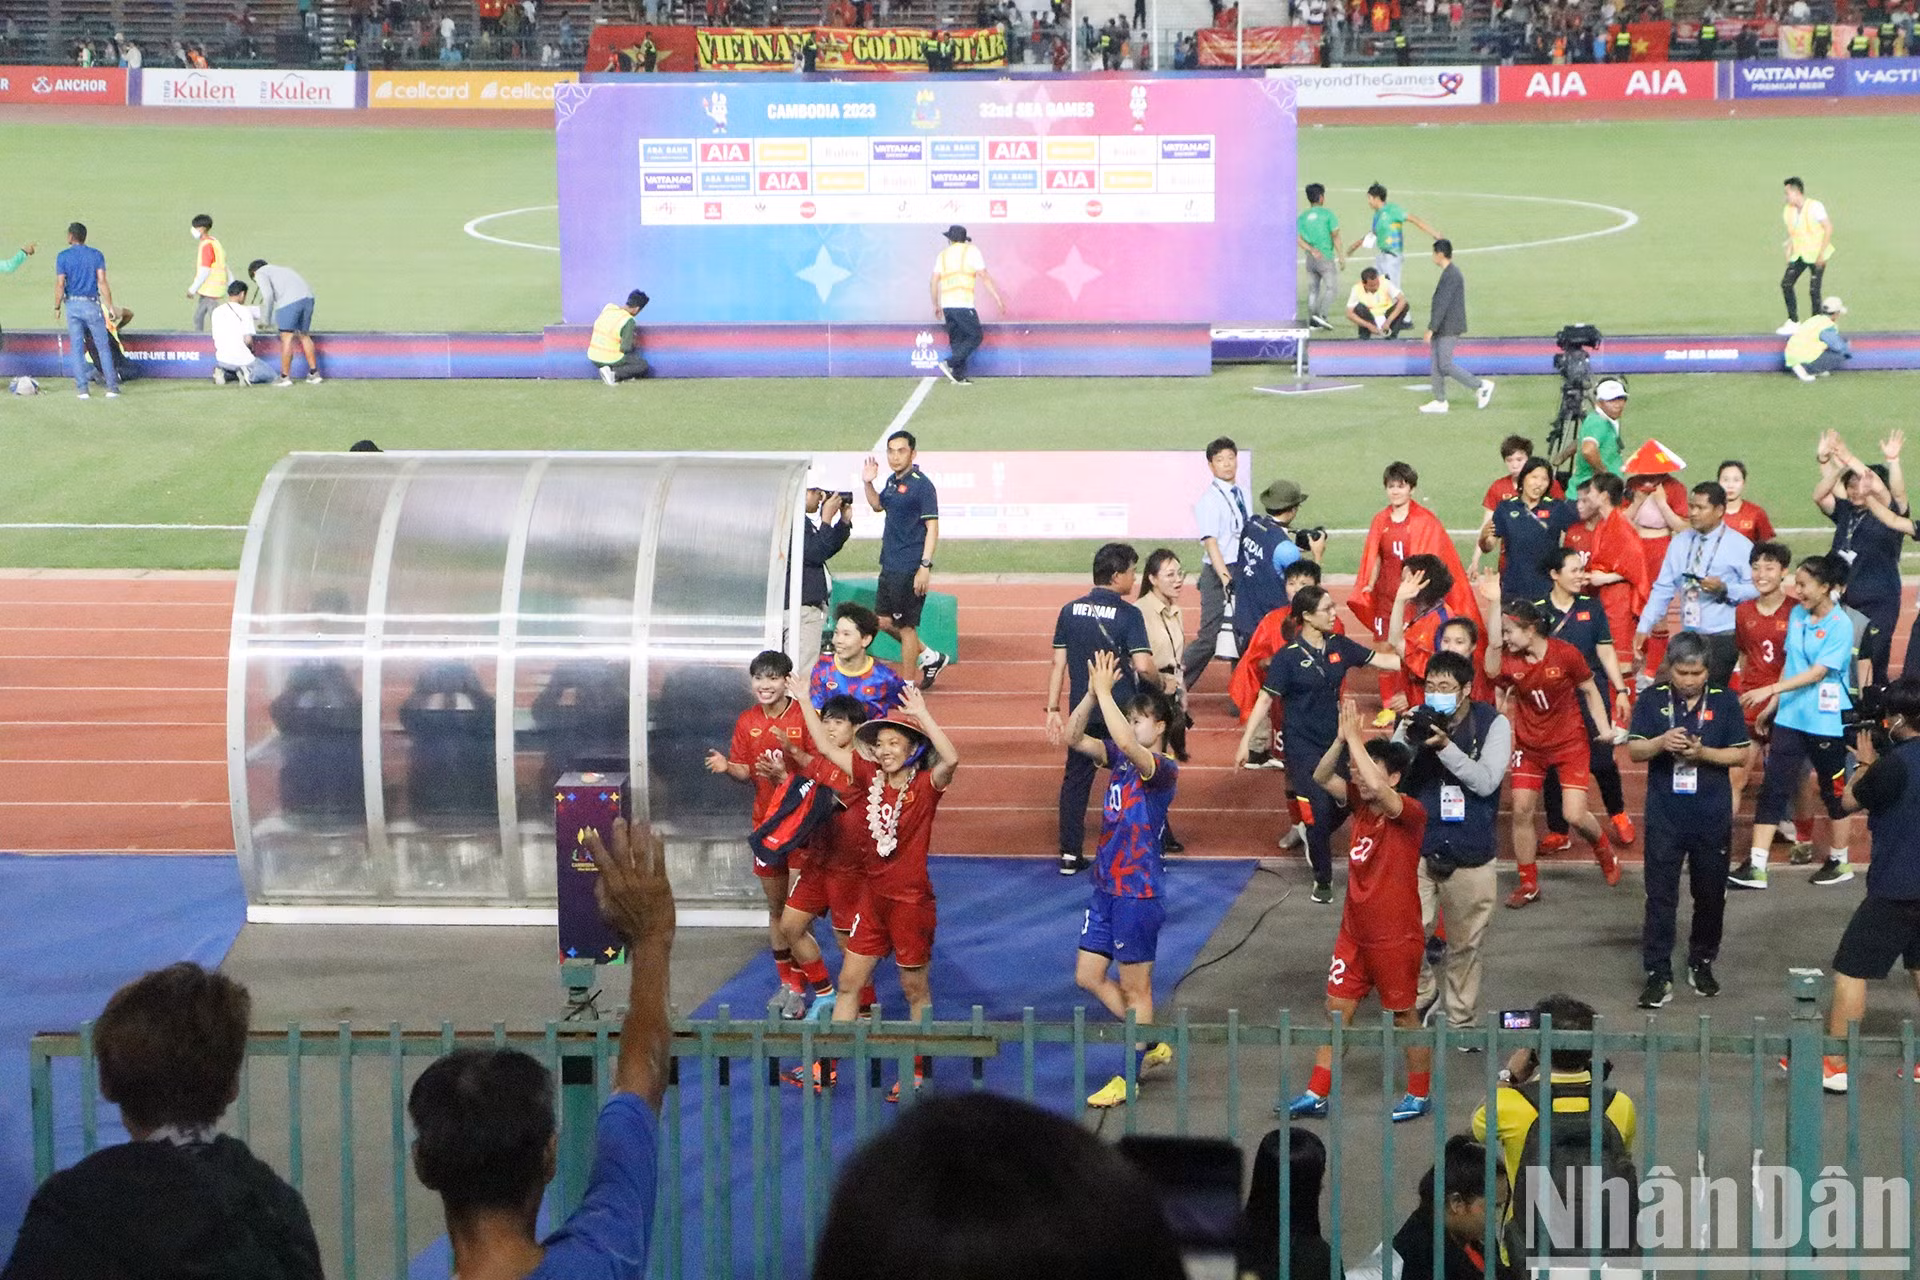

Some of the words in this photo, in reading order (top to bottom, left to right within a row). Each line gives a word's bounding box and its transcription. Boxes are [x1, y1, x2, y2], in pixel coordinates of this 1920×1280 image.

[1625, 69, 1687, 95] AIA
[1743, 66, 1835, 82] VATTANAC
[1855, 68, 1920, 83] V-ACTI
[55, 79, 107, 92] ANCHOR
[174, 79, 234, 99] Kulen
[271, 81, 331, 100] Kulen
[394, 81, 469, 99] cellcard
[500, 82, 554, 99] cellca
[1525, 71, 1587, 97] AIA
[1751, 83, 1797, 91] PREMIUM
[1798, 82, 1825, 90] BEER
[767, 104, 839, 119] CAMBODIA
[842, 103, 876, 118] 2023
[979, 102, 1012, 117] 32nd
[1015, 102, 1042, 117] SEA
[1045, 102, 1094, 117] GAMES
[707, 144, 743, 161] AIA
[875, 144, 920, 153] VATTANAC
[995, 142, 1031, 159] AIA
[1162, 143, 1209, 152] VATTANAC
[644, 176, 691, 185] VATTANAC
[765, 173, 801, 189] AIA
[932, 173, 978, 182] VATTANAC
[1053, 171, 1089, 187] AIA
[1392, 541, 1404, 560] 4
[1072, 603, 1117, 620] VIETNAM
[1374, 617, 1382, 636] 4
[1762, 640, 1774, 663] 3
[1531, 690, 1549, 710] 11
